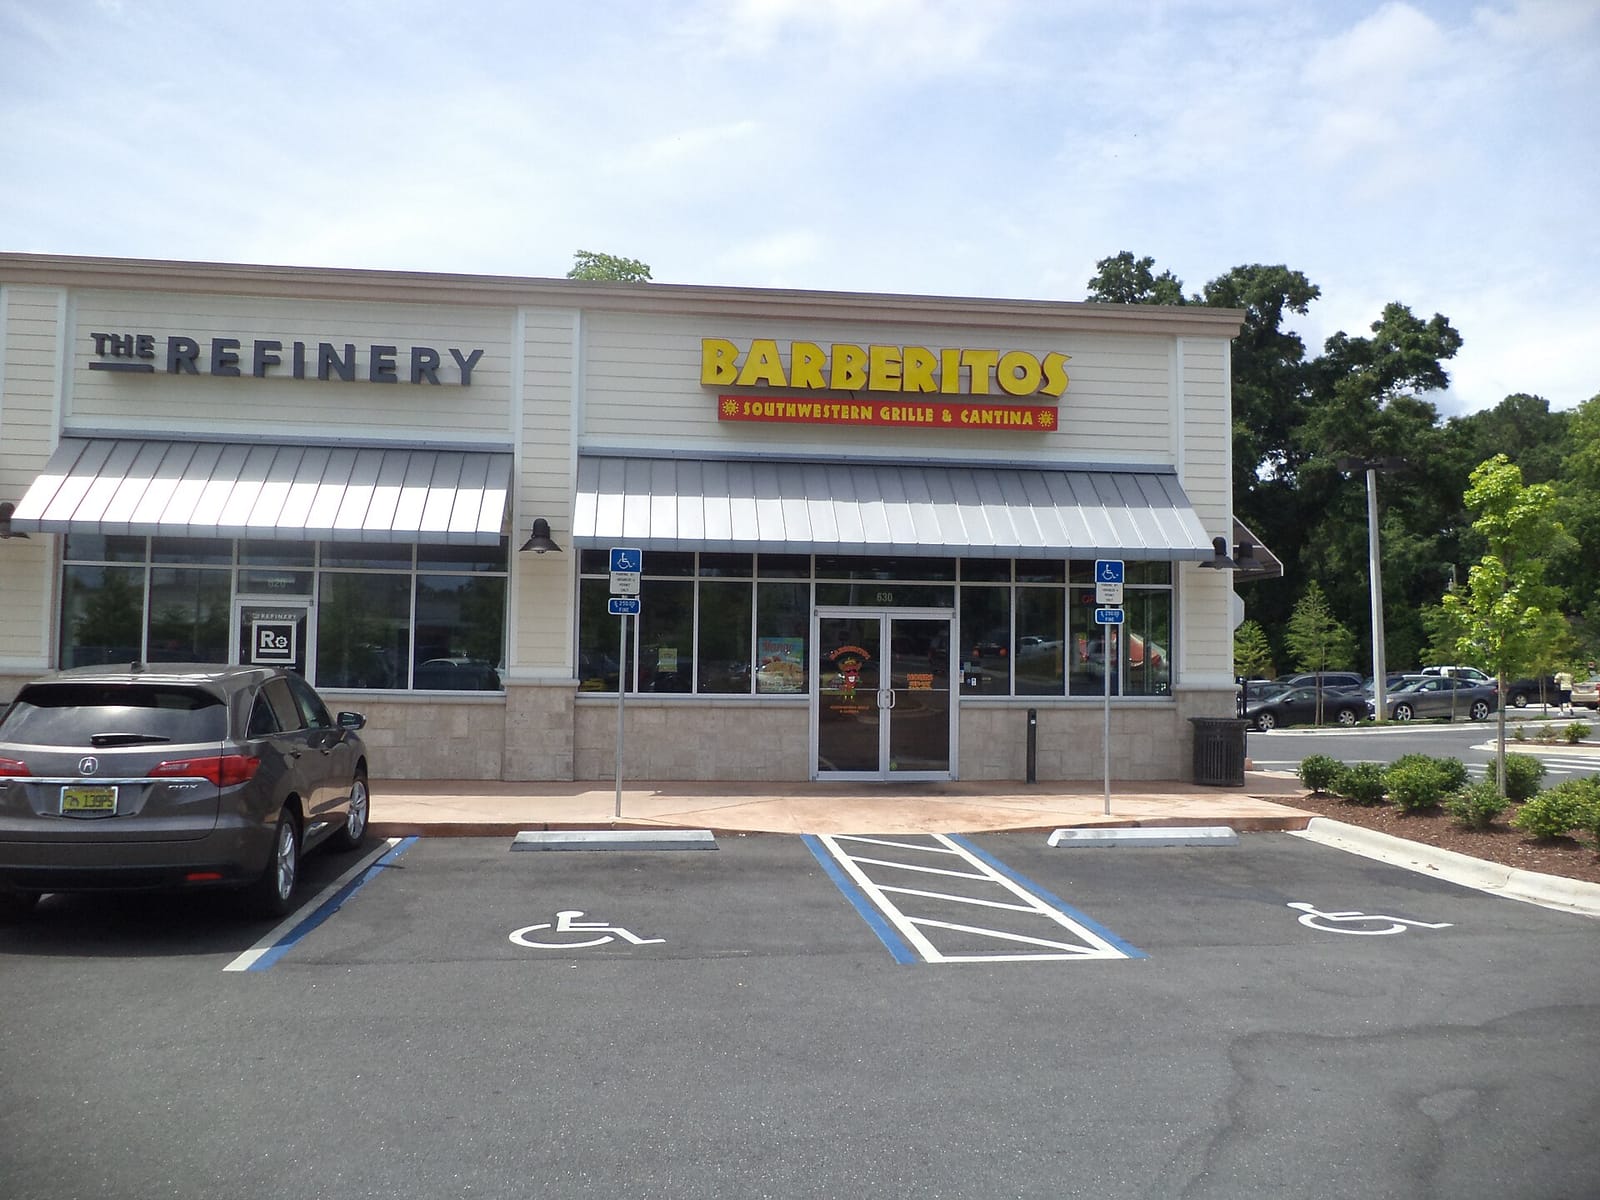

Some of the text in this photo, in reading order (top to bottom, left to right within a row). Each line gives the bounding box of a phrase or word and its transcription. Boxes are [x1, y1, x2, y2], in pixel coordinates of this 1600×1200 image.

[90, 332, 485, 386] THE REFINERY
[700, 338, 1073, 398] BARBERITOS
[742, 400, 1034, 427] SOUTHWESTERN GRILLE & CANTINA
[876, 592, 893, 602] 630
